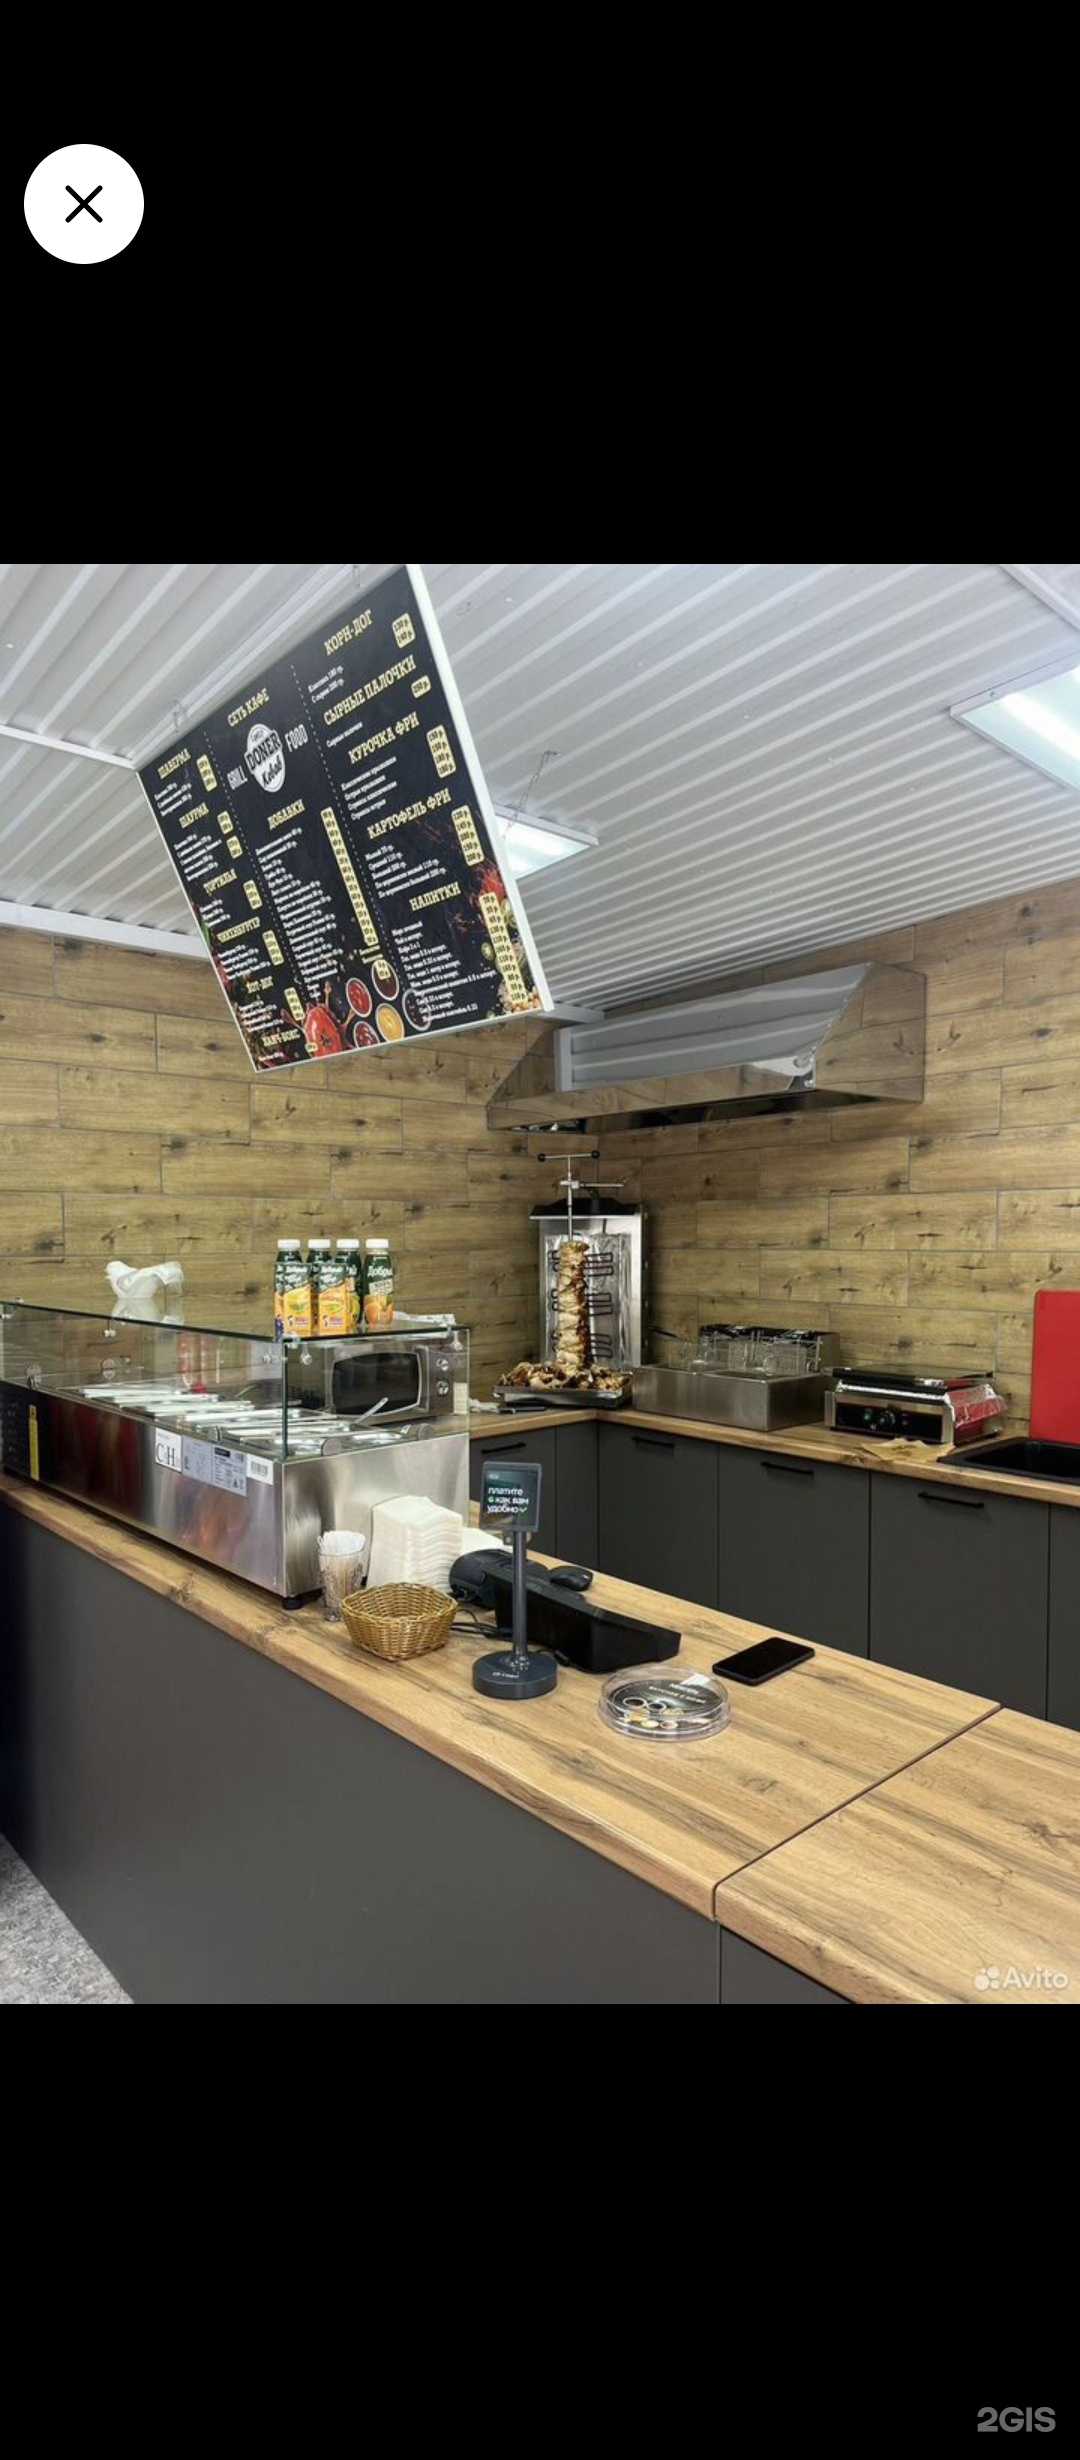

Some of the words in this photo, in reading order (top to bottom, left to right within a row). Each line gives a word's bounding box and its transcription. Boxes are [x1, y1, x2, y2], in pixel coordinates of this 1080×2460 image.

[324, 609, 372, 656] КОРН-ДОГ
[227, 706, 248, 727] СЕТЬ
[246, 688, 270, 714] КАФЕ
[324, 689, 365, 725] СЫРНЫЕ
[364, 654, 416, 699] ПАЛОЧКИ
[247, 732, 282, 771] DONER
[285, 724, 309, 752] FOOD
[348, 727, 396, 764] КУРОЧКА
[395, 711, 419, 735] ФРИ
[267, 799, 305, 831] ДОБАВКИ
[367, 801, 427, 839] КАРТОФЕЛЬ
[427, 788, 451, 809] ФРИ
[409, 882, 461, 911] НАПИТКИ
[487, 1504, 519, 1514] удобно
[488, 1487, 524, 1497] платите
